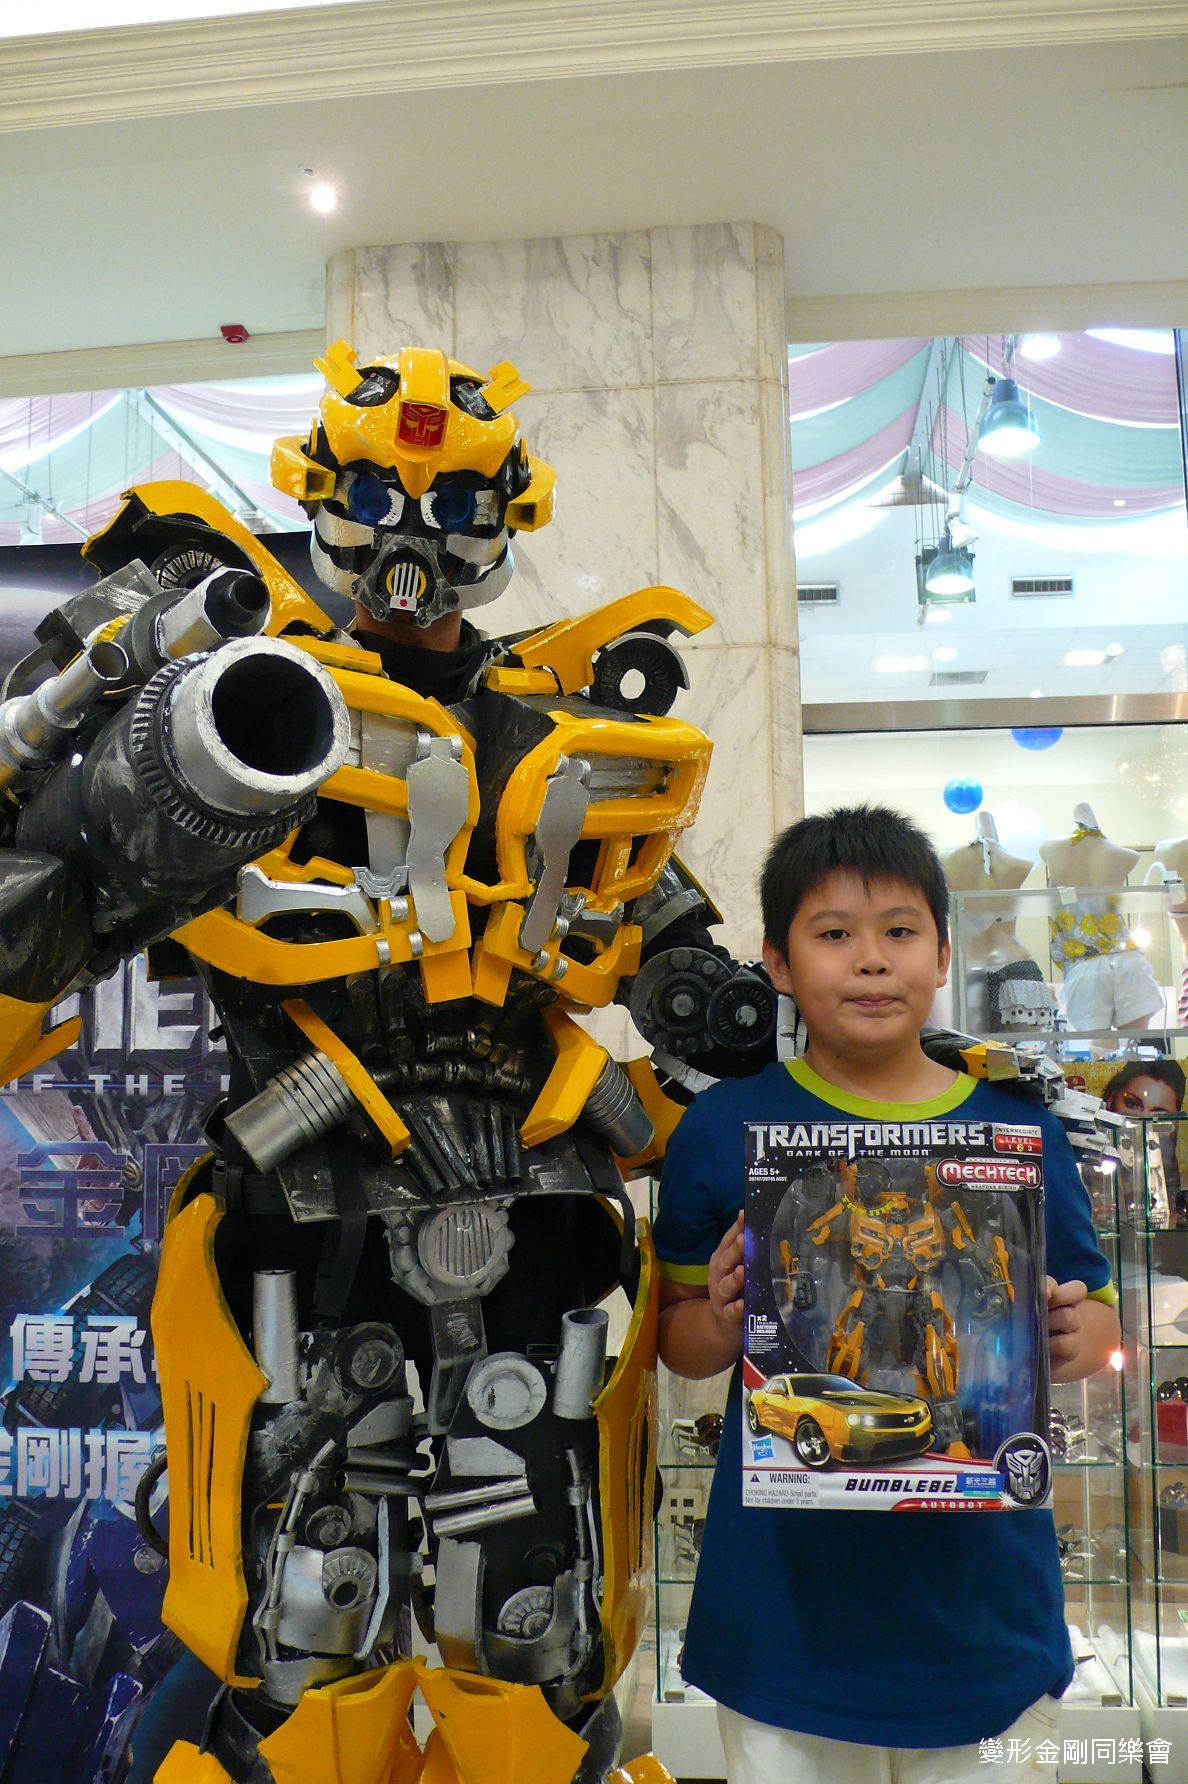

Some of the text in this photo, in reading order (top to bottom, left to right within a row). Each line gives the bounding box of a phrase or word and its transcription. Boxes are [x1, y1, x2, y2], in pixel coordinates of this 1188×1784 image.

[88, 1074, 186, 1096] THE
[995, 1126, 1038, 1135] INTERMEDIATE
[748, 1124, 985, 1160] TRANSFORMERS
[1005, 1136, 1034, 1144] LEVEL
[859, 1149, 884, 1157] THE
[748, 1168, 780, 1176] AGES 5+
[942, 1163, 1037, 1185] MECHTECH
[10, 1314, 162, 1384] 傳承
[769, 1473, 811, 1484] WARNING:
[920, 1501, 984, 1509] AUTOBOT
